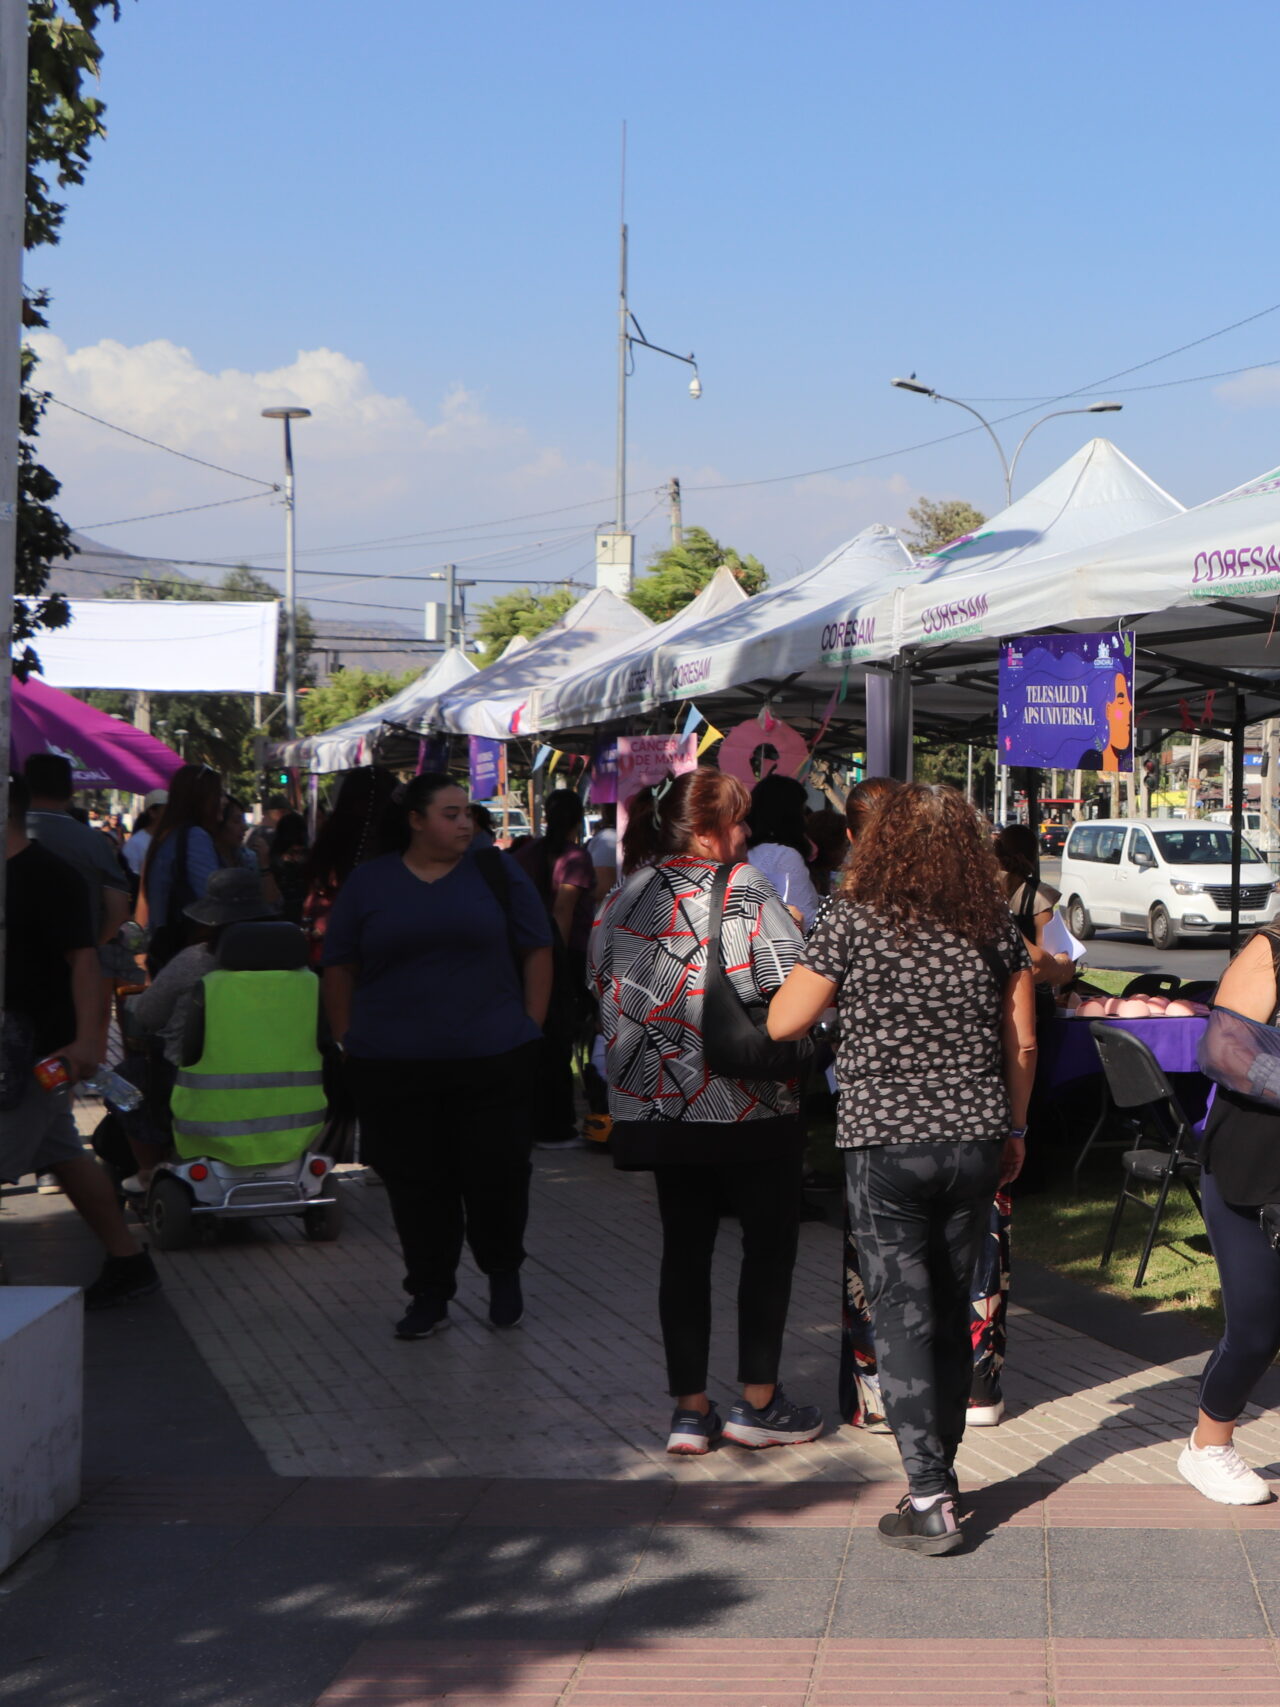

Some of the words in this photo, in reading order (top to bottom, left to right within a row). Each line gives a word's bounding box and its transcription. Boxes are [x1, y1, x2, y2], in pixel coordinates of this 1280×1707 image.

[921, 593, 989, 634] CORESAM
[821, 616, 876, 651] CORESAM
[1025, 685, 1080, 703] TELESALUD
[1080, 685, 1088, 703] Y
[1023, 706, 1039, 724] APS
[1040, 707, 1096, 725] UNIVERSAL
[635, 754, 651, 766] DE
[655, 752, 693, 765] MAMA
